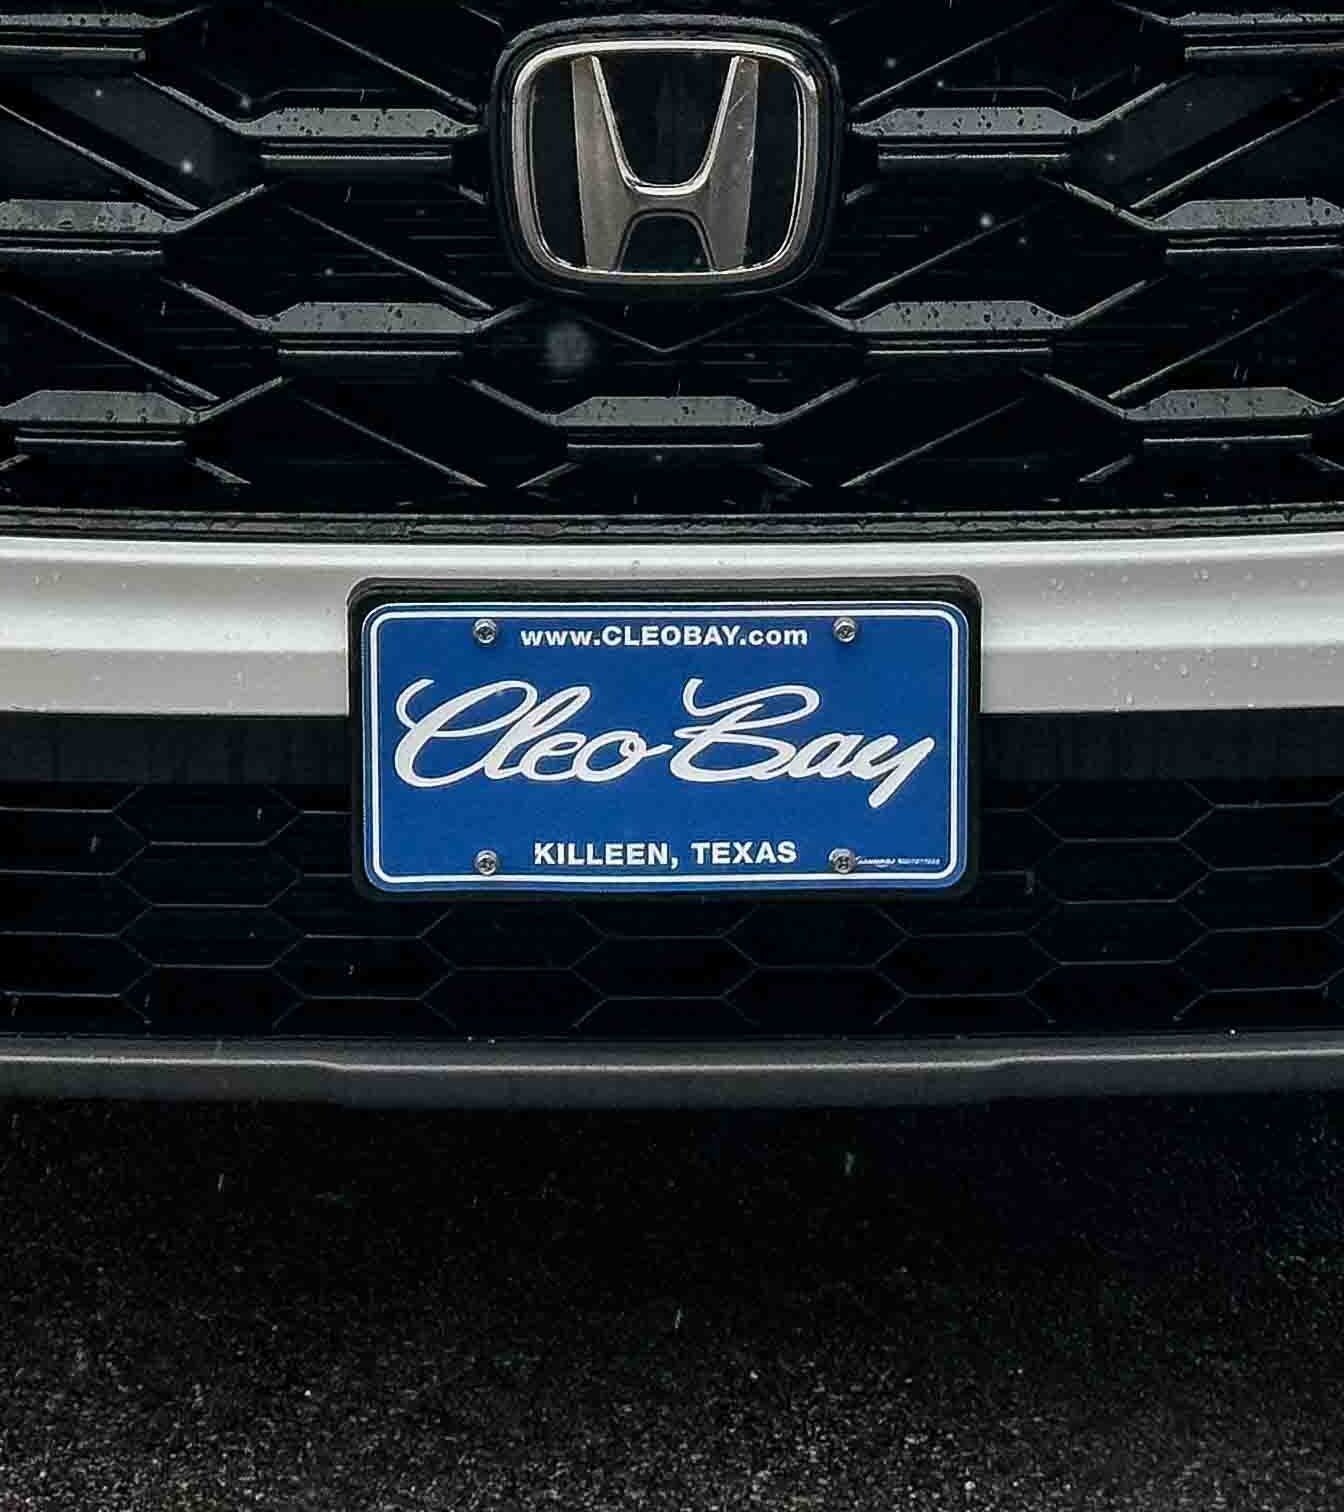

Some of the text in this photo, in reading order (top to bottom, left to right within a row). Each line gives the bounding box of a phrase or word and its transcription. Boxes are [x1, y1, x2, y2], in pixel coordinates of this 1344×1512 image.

[520, 624, 809, 648] www.CLEOBAY.com
[394, 678, 936, 810] Cleo Bay
[533, 840, 798, 870] KILLEEN, TEXAS
